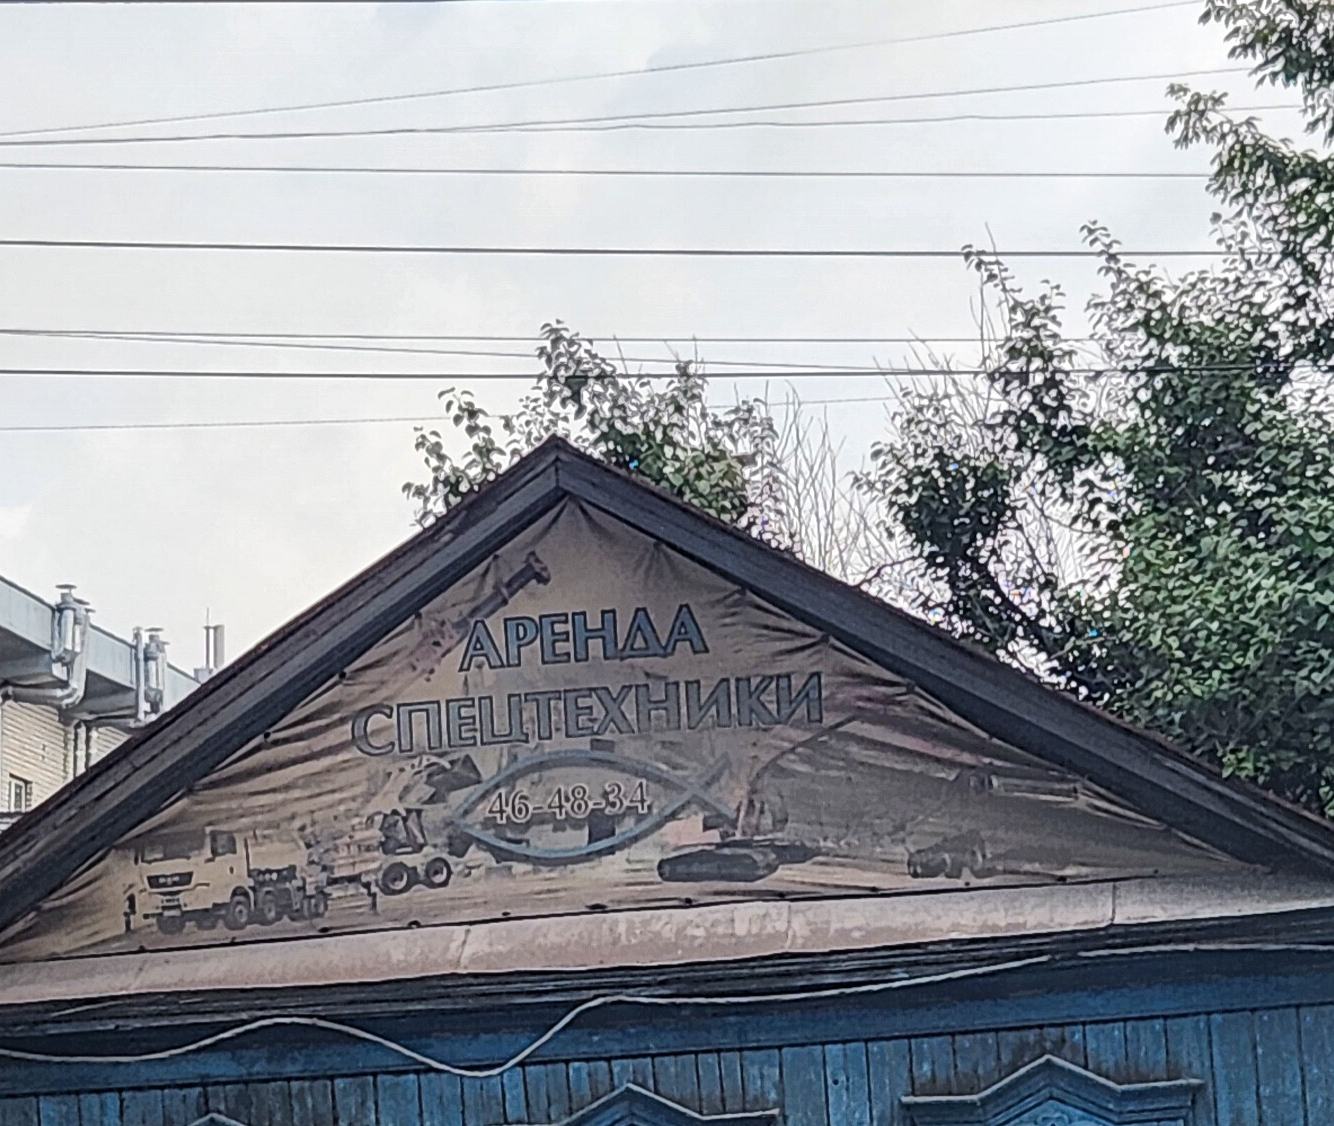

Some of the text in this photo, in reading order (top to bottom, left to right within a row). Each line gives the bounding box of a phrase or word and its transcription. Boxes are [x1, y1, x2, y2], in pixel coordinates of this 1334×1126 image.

[458, 603, 710, 672] АРЕНДА
[351, 672, 824, 757] СПЕЦТЕХНИКИ
[486, 780, 651, 823] 46-48-34
